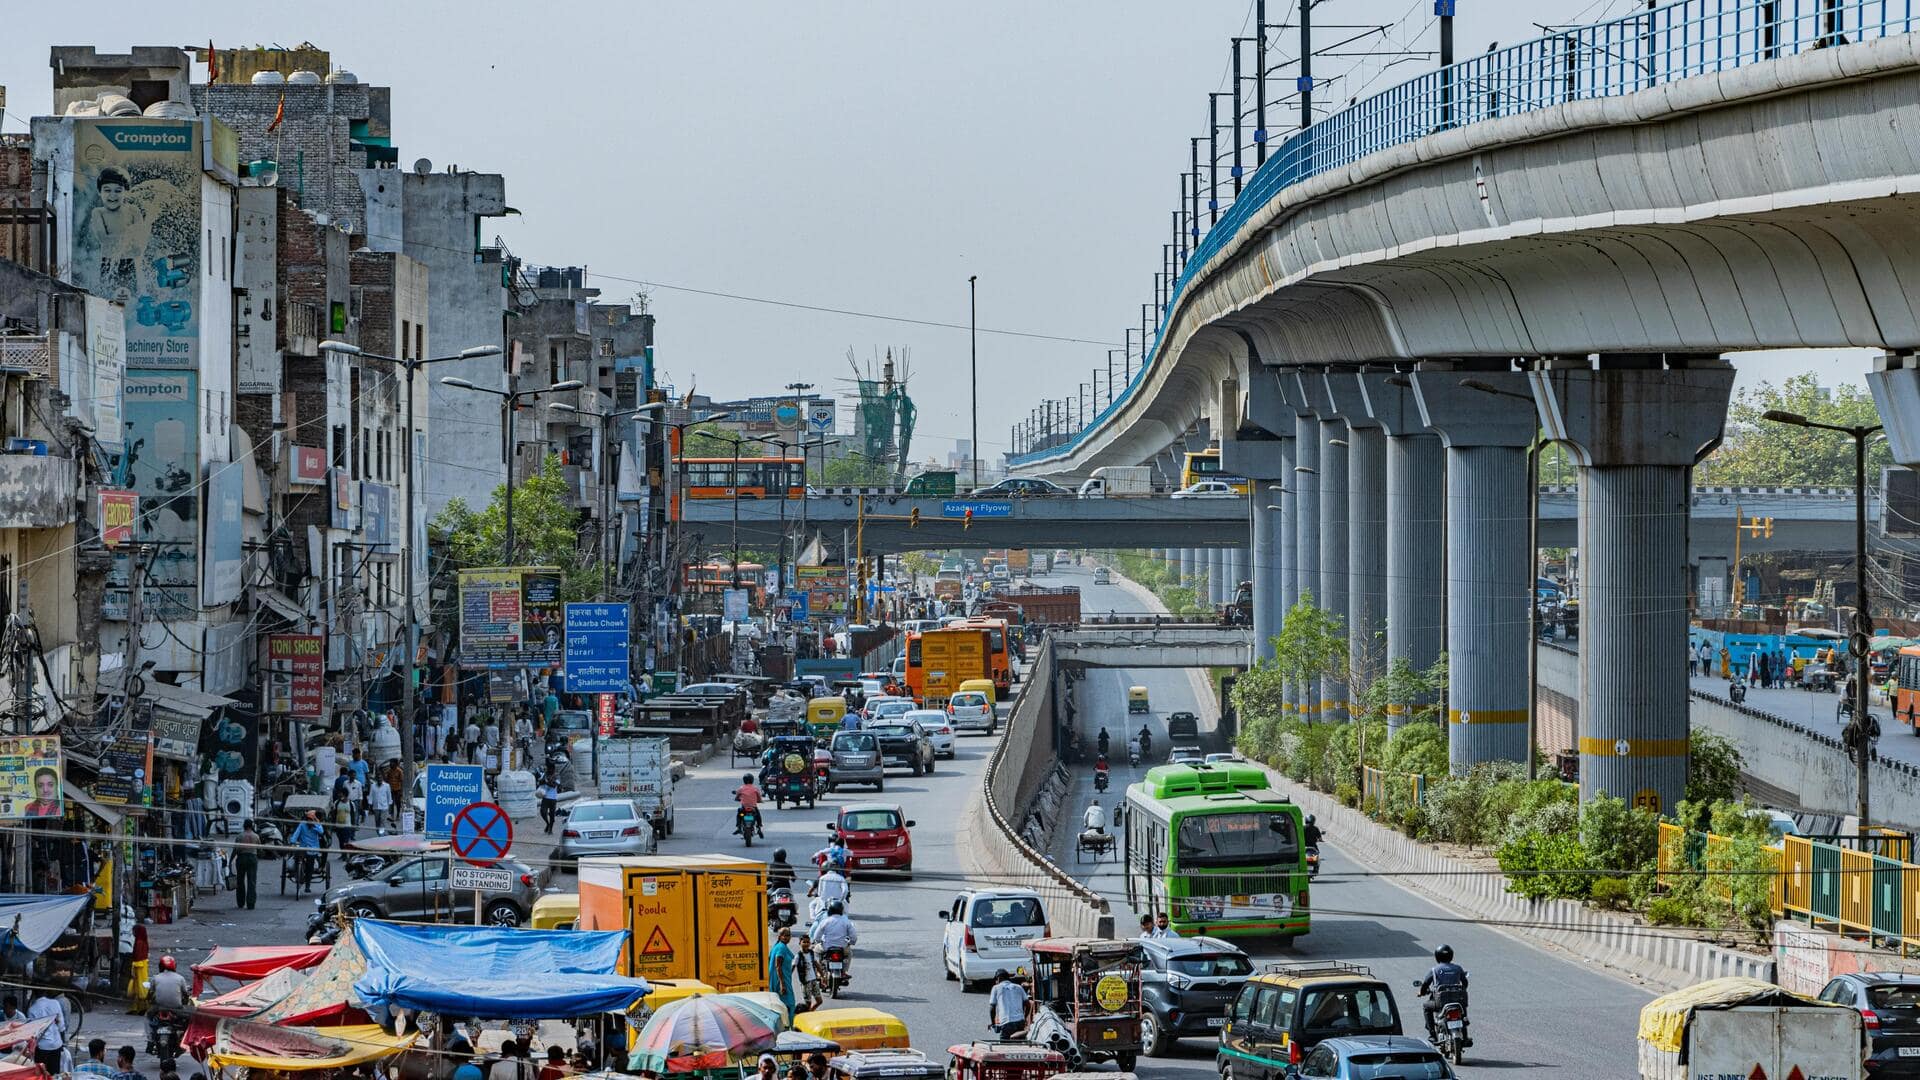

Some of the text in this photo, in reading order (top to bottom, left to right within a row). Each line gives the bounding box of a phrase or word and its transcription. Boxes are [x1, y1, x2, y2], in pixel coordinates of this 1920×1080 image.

[115, 131, 186, 146] Crompton
[166, 339, 189, 353] Store
[125, 384, 182, 396] ompton
[816, 412, 828, 420] HP
[980, 504, 1010, 513] Flyover
[272, 640, 320, 655] TONI SHOES
[609, 679, 629, 688] Bagh
[438, 770, 473, 781] Azadpur
[430, 782, 479, 793] Commercial
[435, 795, 472, 807] Complex
[456, 870, 509, 882] NO STOPPING
[469, 880, 508, 889] STANDING
[635, 1020, 644, 1029] 20
[515, 1027, 528, 1036] 20
